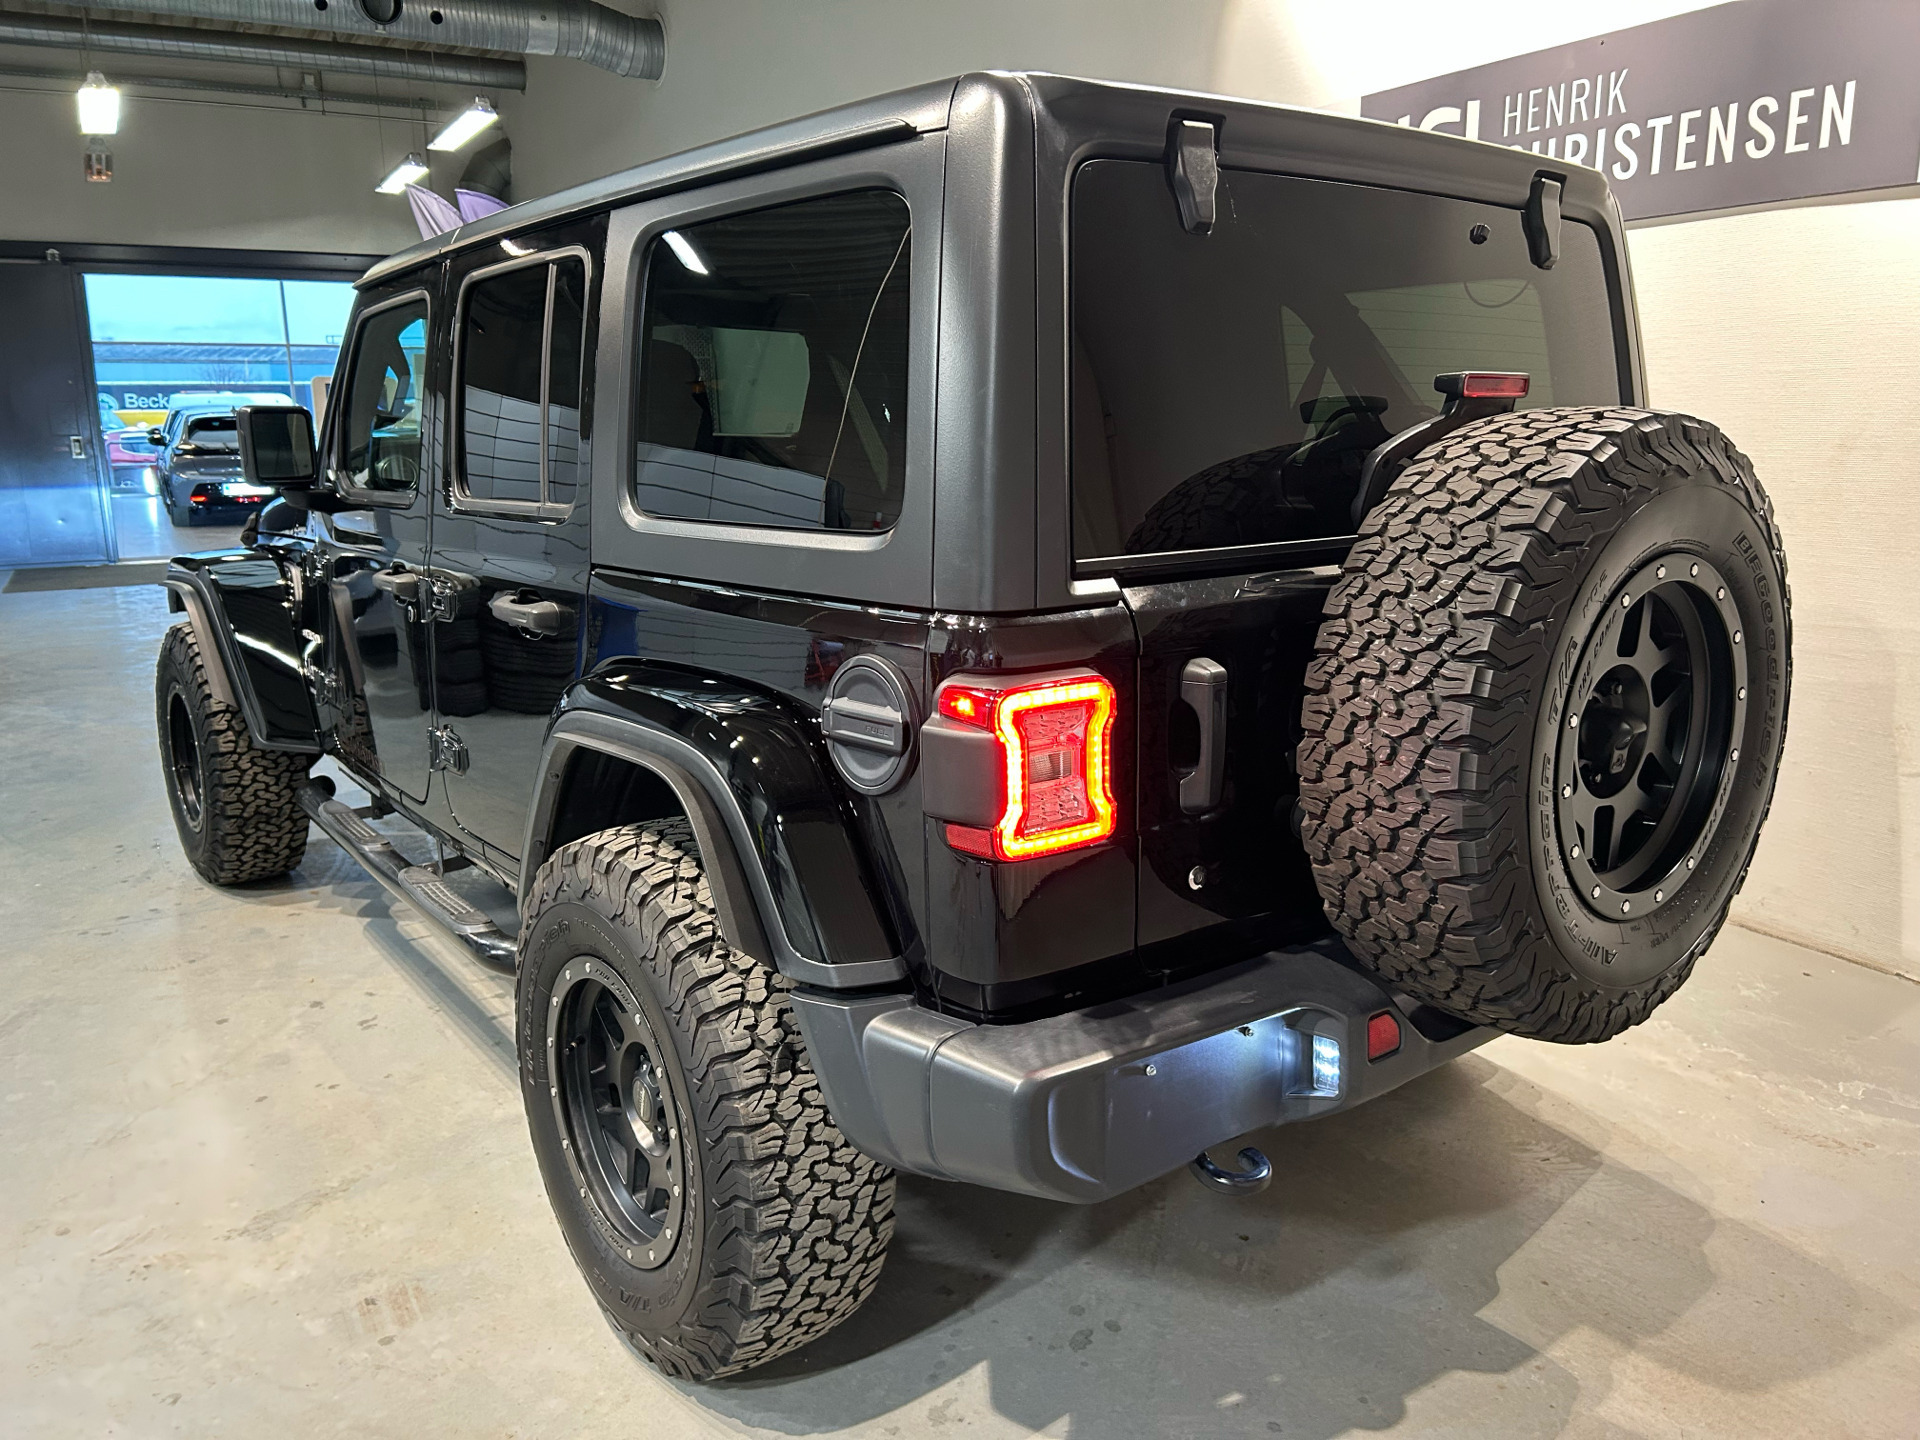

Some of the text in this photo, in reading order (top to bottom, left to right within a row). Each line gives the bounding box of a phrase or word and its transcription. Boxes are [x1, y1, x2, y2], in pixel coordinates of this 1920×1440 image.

[1503, 69, 1629, 138] HENRIK
[1508, 80, 1856, 181] RISTENSEN
[865, 725, 889, 737] FUEL
